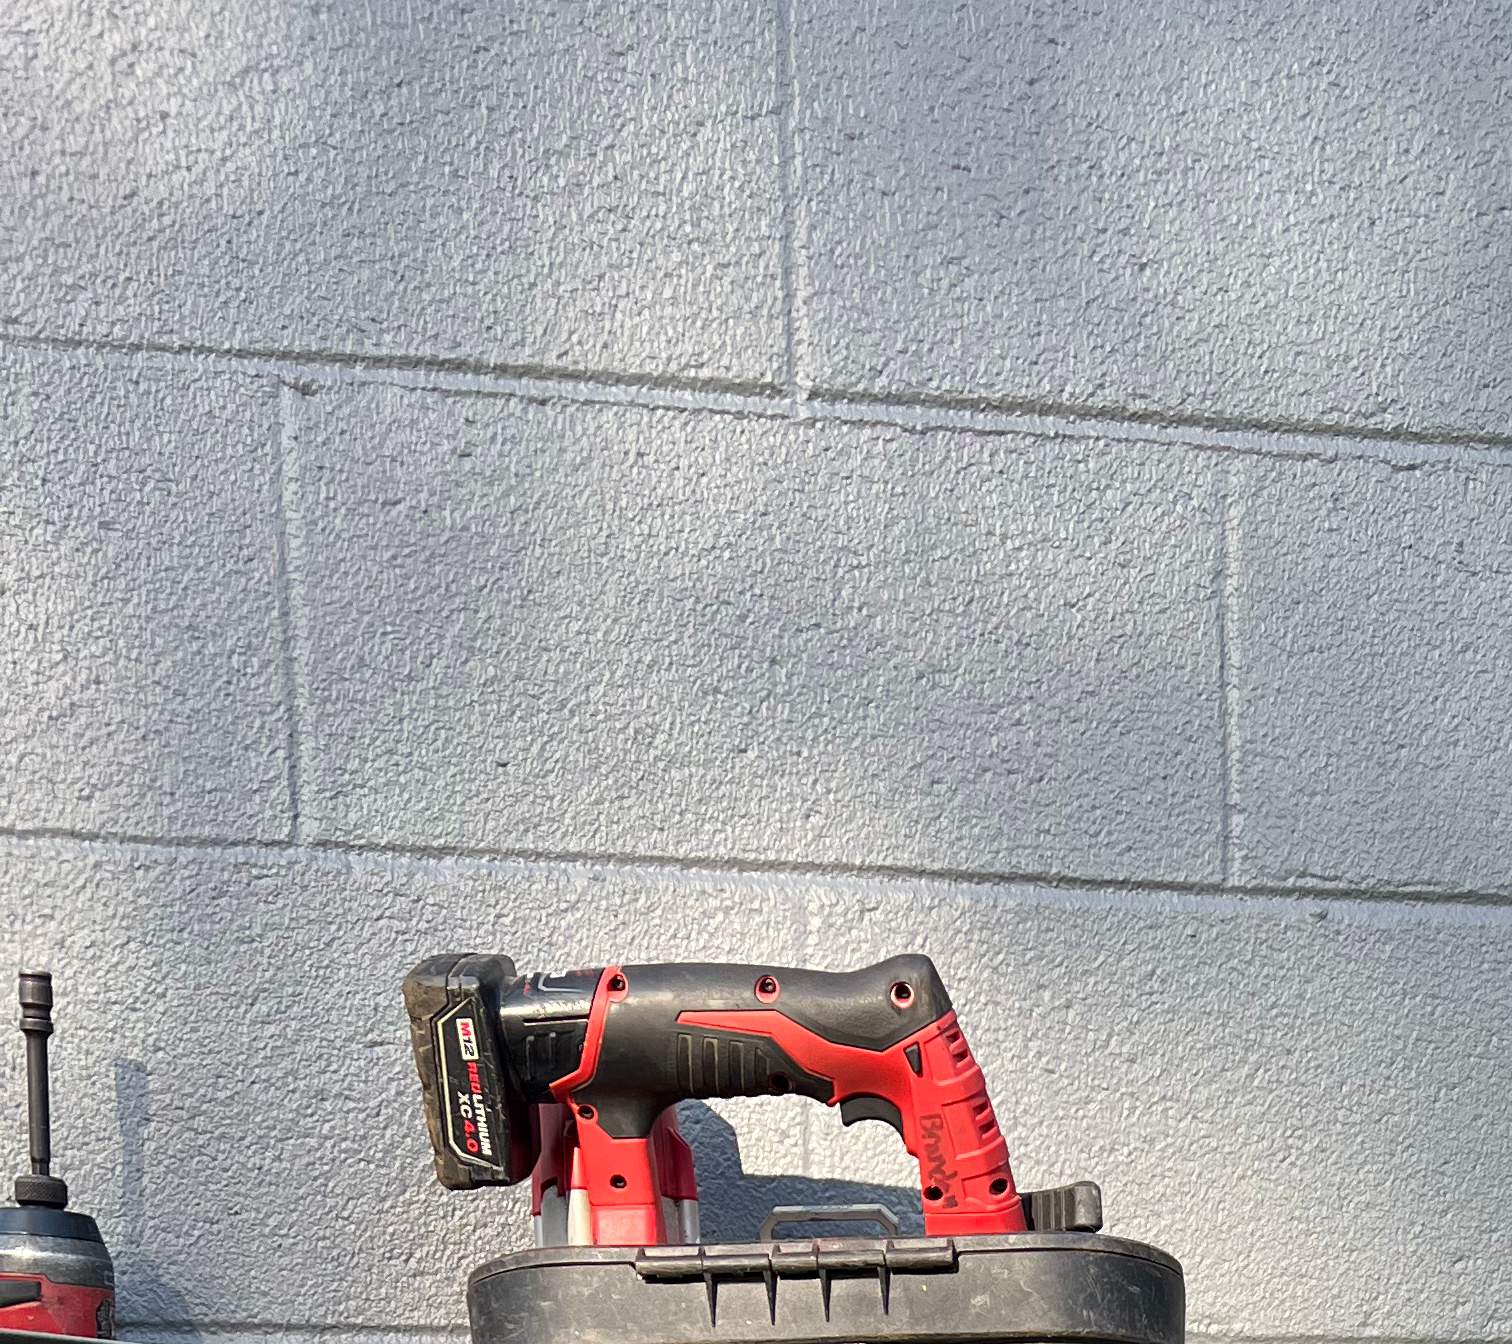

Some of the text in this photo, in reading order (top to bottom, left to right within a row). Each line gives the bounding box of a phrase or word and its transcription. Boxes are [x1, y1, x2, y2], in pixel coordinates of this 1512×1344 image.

[458, 1091, 479, 1153] XC 4.0
[460, 1022, 492, 1156] M12 REDLITHIUM
